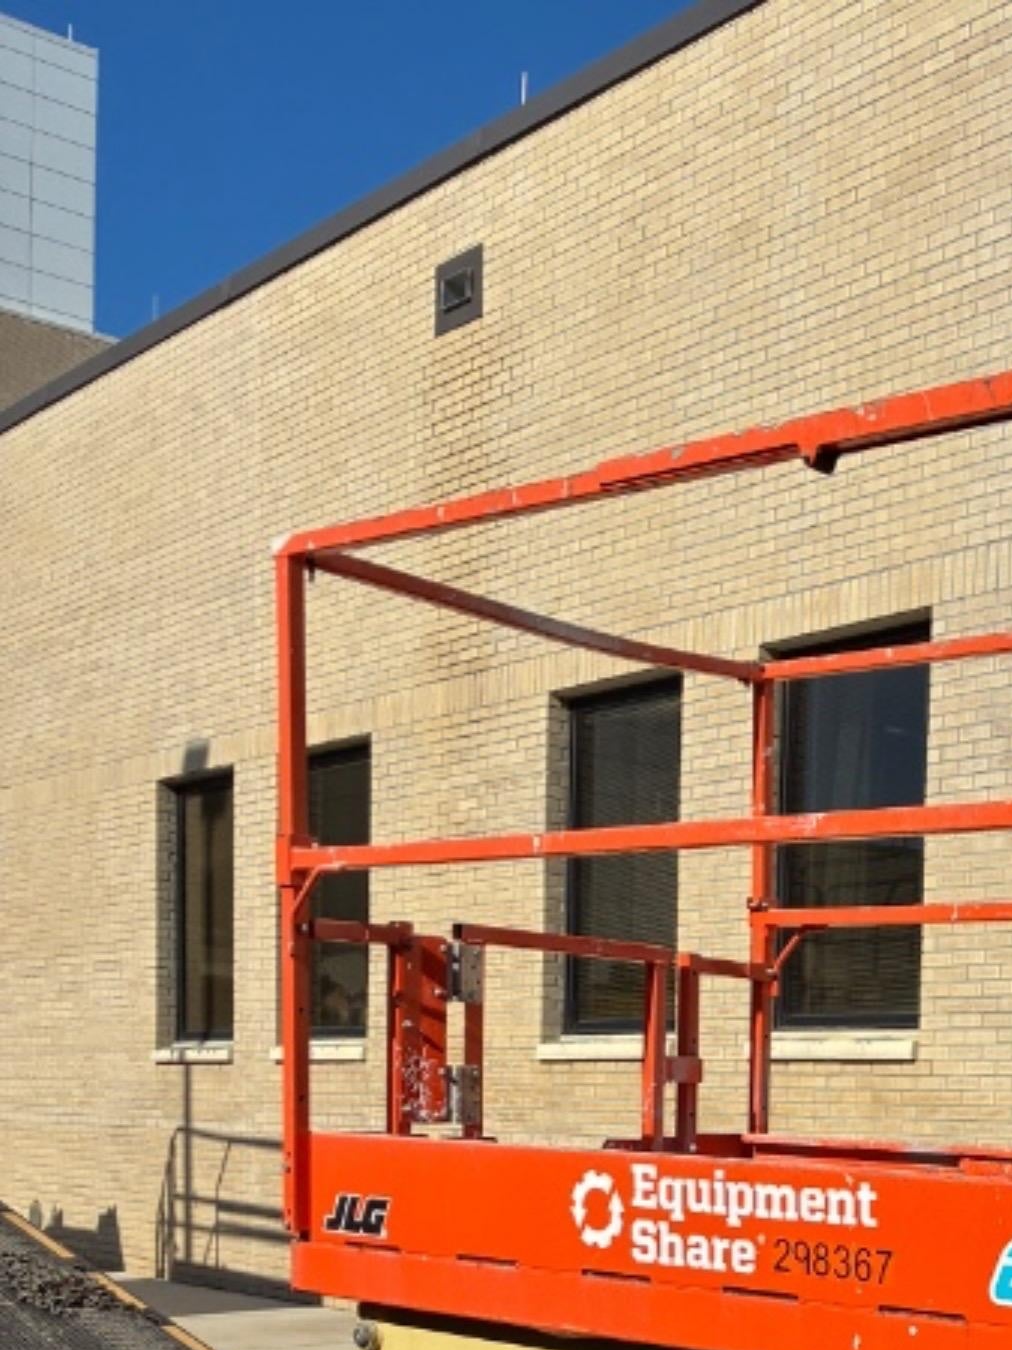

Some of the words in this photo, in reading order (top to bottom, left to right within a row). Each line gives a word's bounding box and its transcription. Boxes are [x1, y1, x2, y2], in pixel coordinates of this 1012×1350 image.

[324, 1193, 392, 1239] JLG
[631, 1162, 878, 1228] Equipment
[631, 1218, 757, 1274] Share
[772, 1238, 893, 1285] 298367
